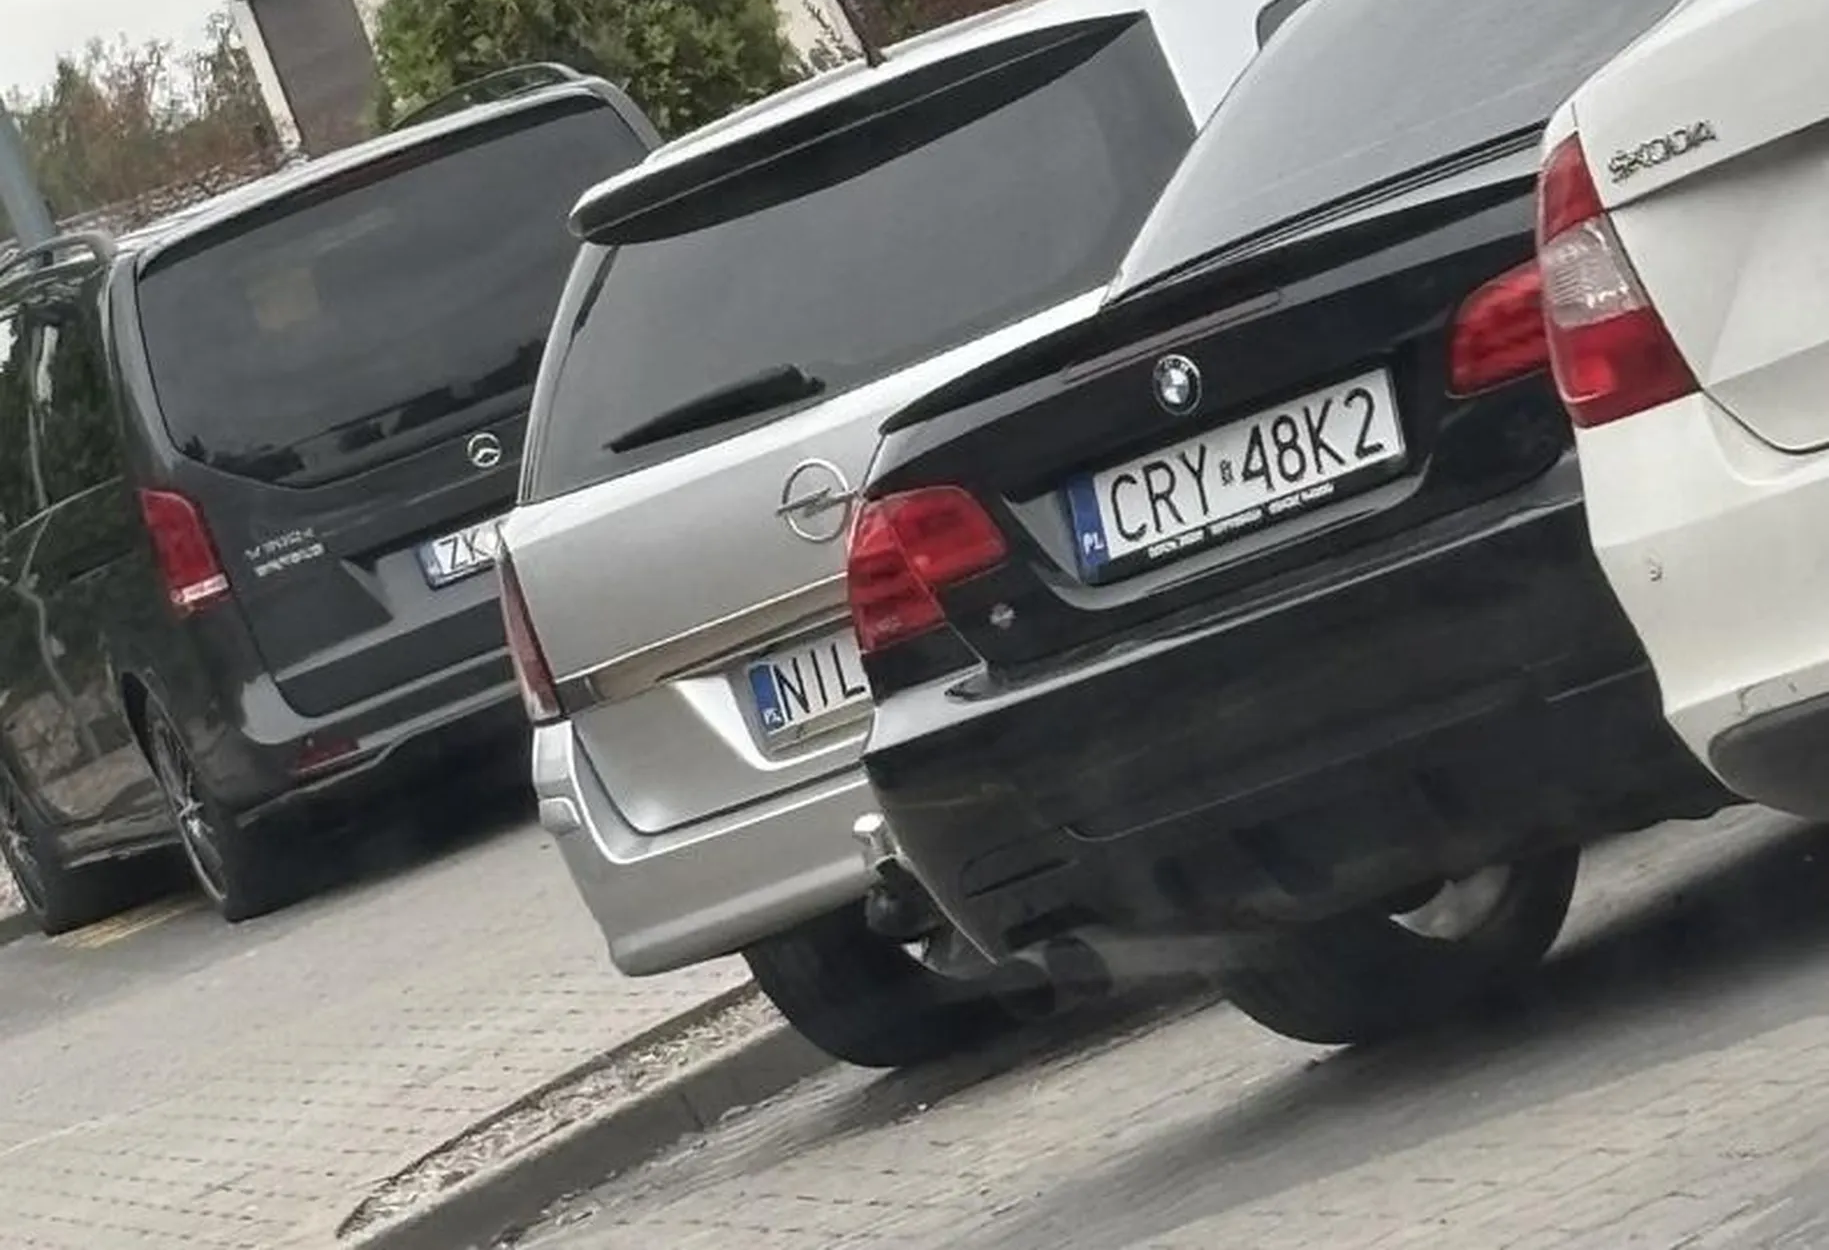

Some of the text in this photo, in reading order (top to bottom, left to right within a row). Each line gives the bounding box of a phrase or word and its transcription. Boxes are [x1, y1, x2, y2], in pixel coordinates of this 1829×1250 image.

[1110, 446, 1209, 543] CRY
[1239, 386, 1385, 493] 48K2
[438, 528, 489, 571] ZK
[773, 643, 866, 721] NIL
